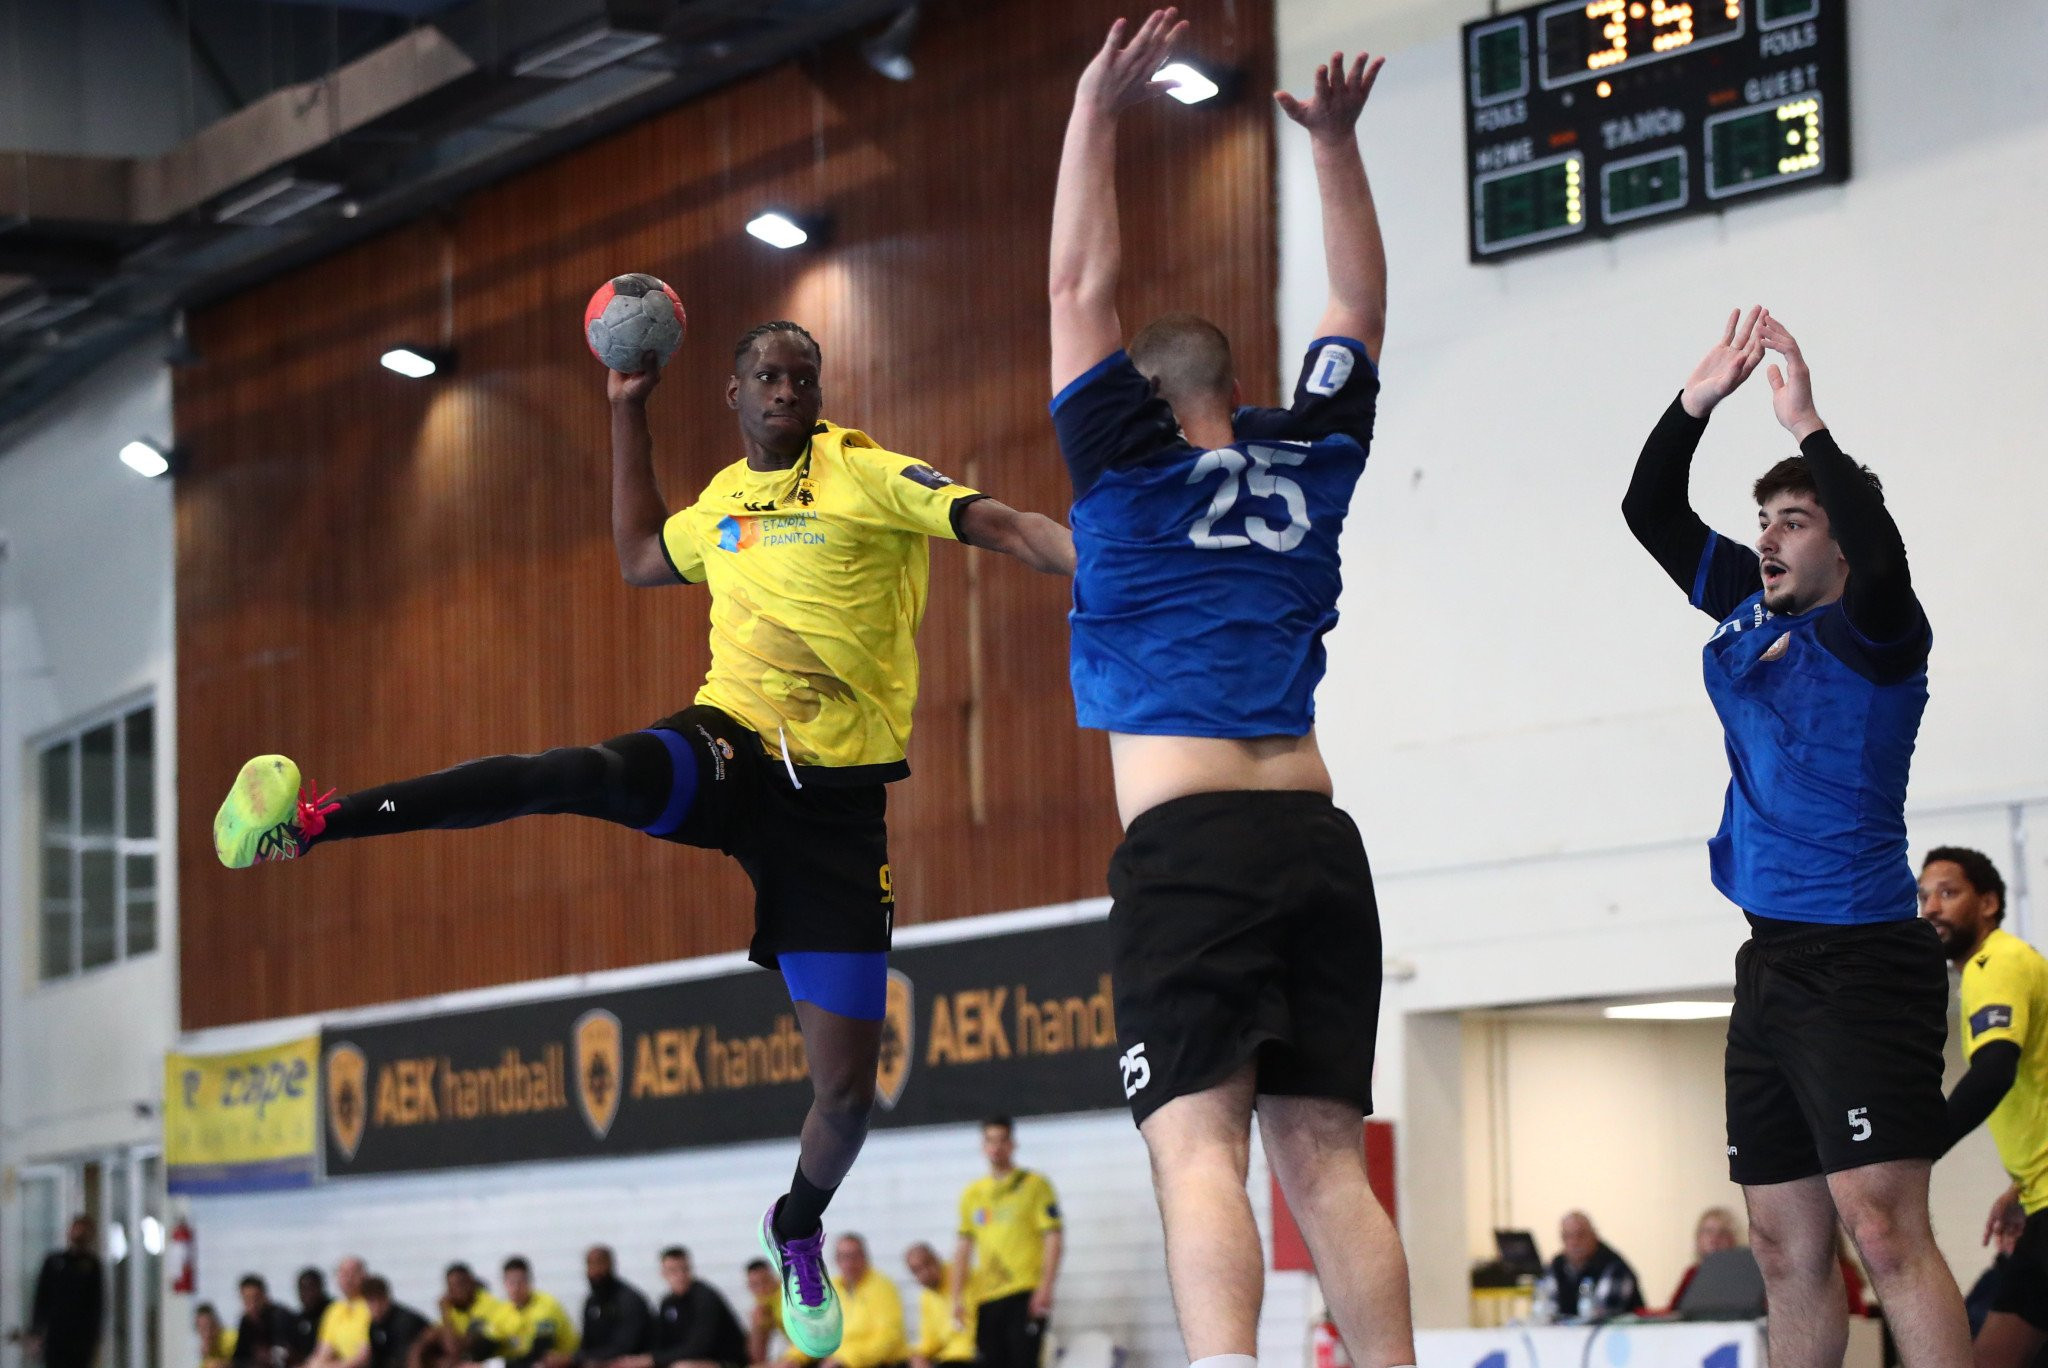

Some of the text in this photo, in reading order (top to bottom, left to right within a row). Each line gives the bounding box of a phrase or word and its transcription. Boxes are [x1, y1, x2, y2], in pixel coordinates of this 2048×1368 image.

[1744, 64, 1819, 104] GUEST
[1776, 98, 1820, 174] 3
[1565, 158, 1582, 225] 1
[1186, 448, 1312, 552] 25
[763, 532, 827, 547] ΓΡΑΝΙΤΩΝ
[879, 864, 895, 903] 9
[926, 972, 1117, 1066] AEK hand
[374, 1041, 568, 1128] AEK handball
[631, 1013, 810, 1099] AEK handb
[1119, 1042, 1151, 1100] 25
[1847, 1107, 1873, 1142] 5
